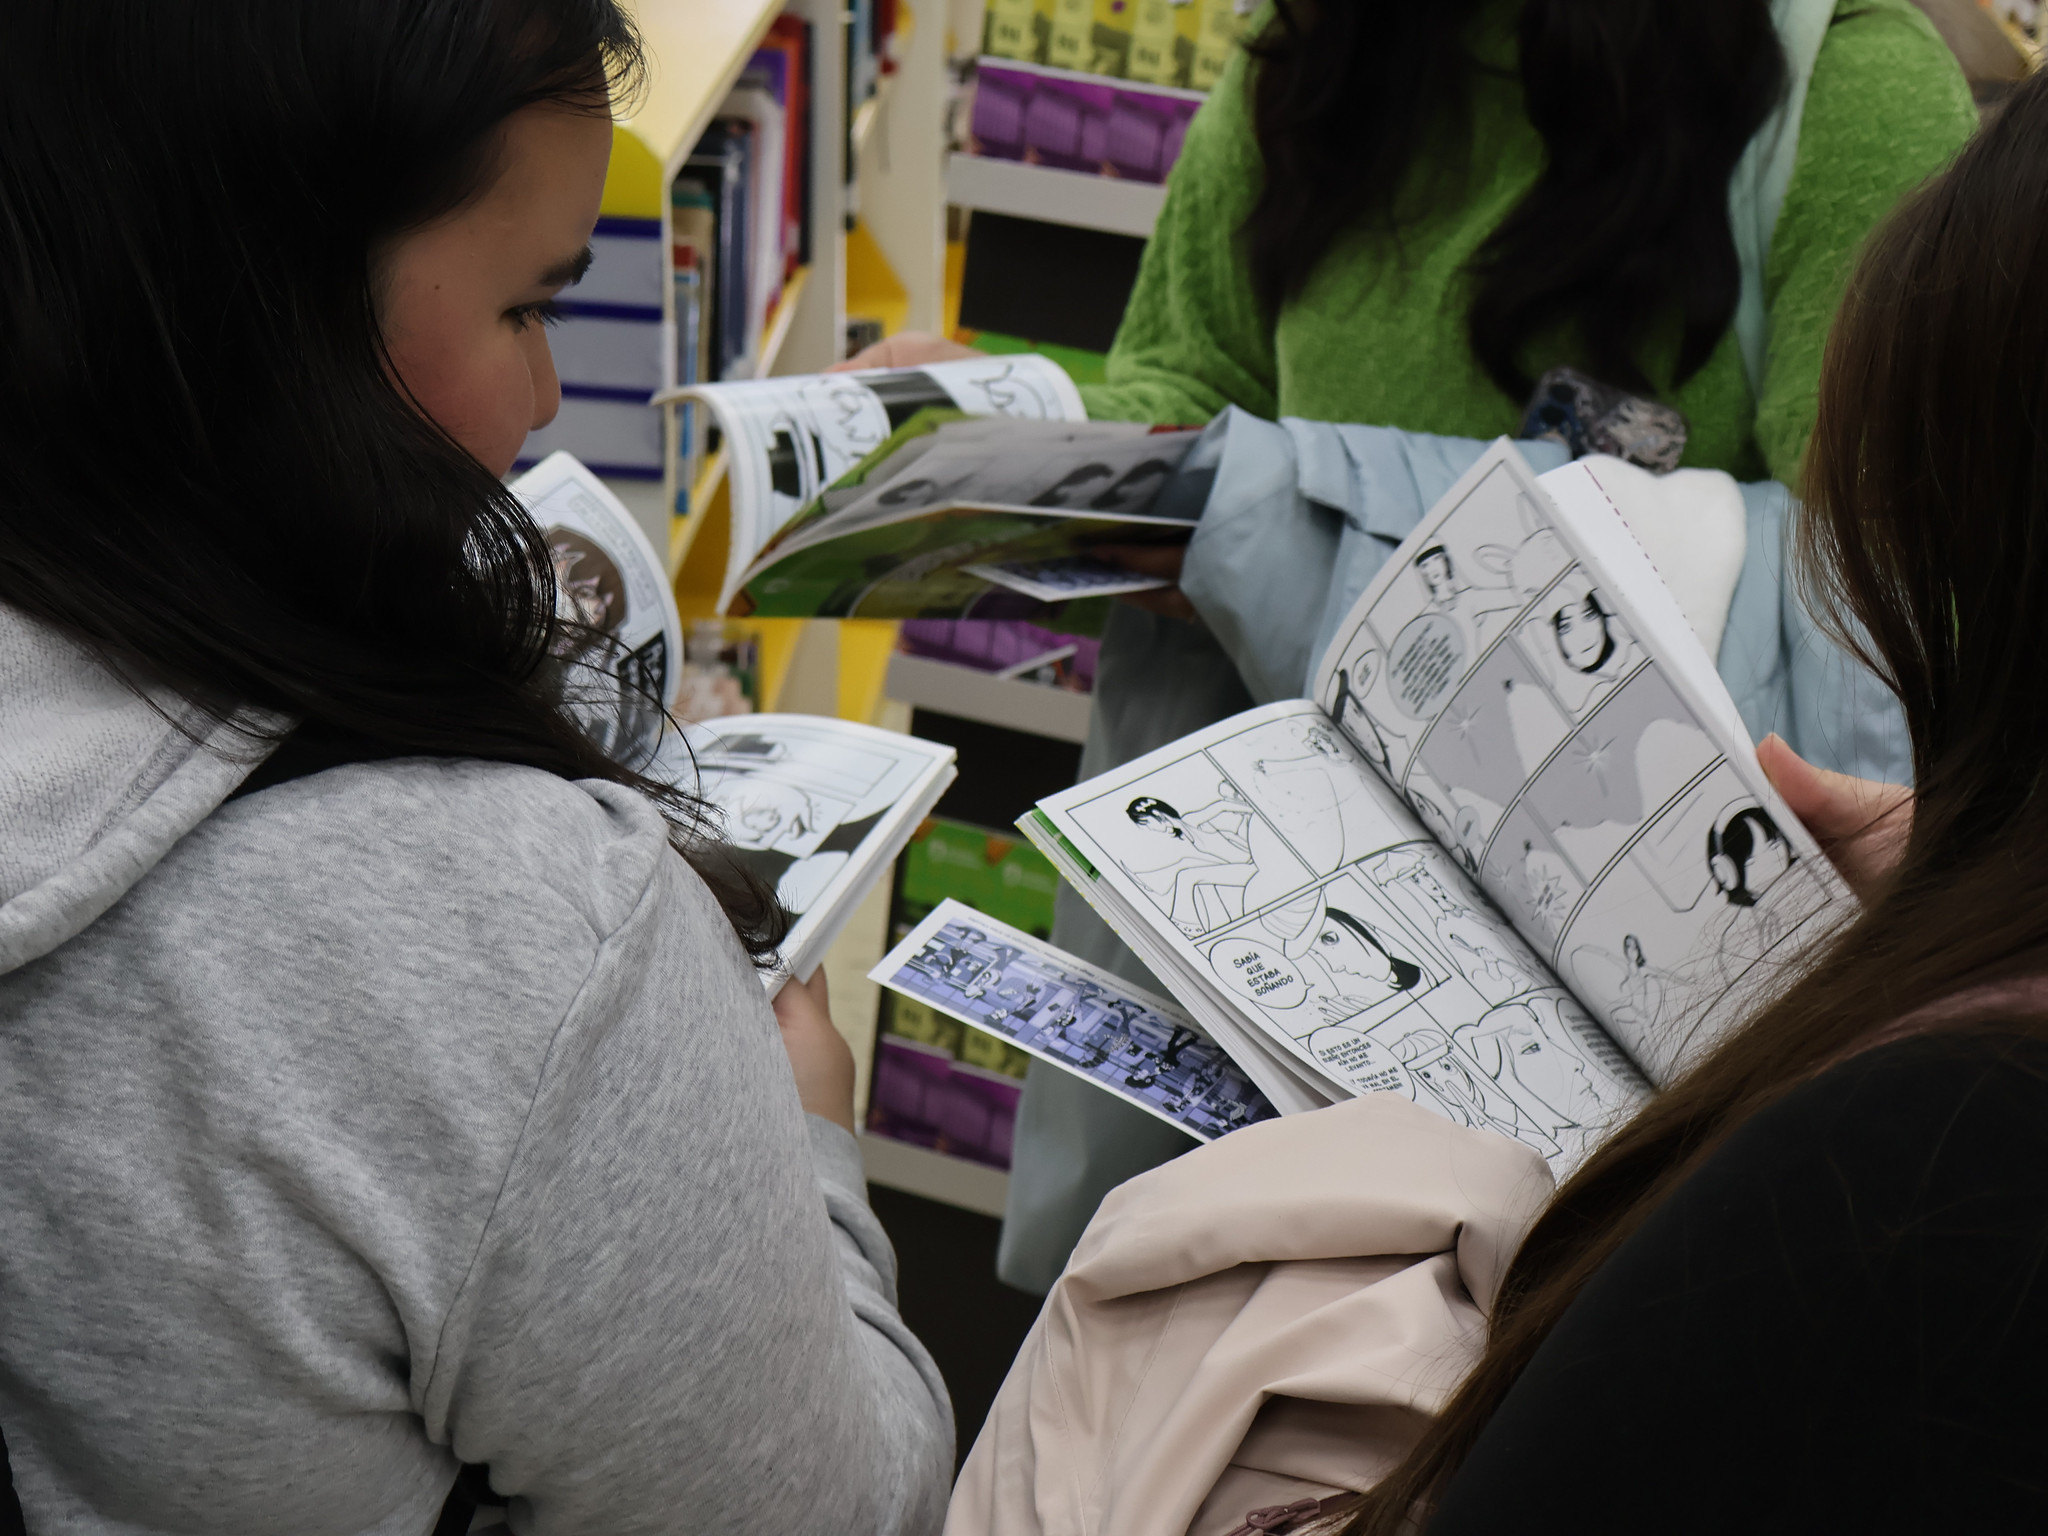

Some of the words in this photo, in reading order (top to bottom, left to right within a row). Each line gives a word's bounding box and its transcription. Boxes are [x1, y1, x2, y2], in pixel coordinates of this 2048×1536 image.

[1233, 952, 1260, 968] SABÍA
[1246, 963, 1265, 975] QUE
[1247, 968, 1281, 987] ESTABA
[1255, 975, 1294, 996] SOÑANDO
[1326, 1044, 1342, 1054] ESTO
[1341, 1042, 1371, 1058] ENTONCES
[1358, 1052, 1368, 1060] ME
[1388, 1066, 1399, 1074] ME
